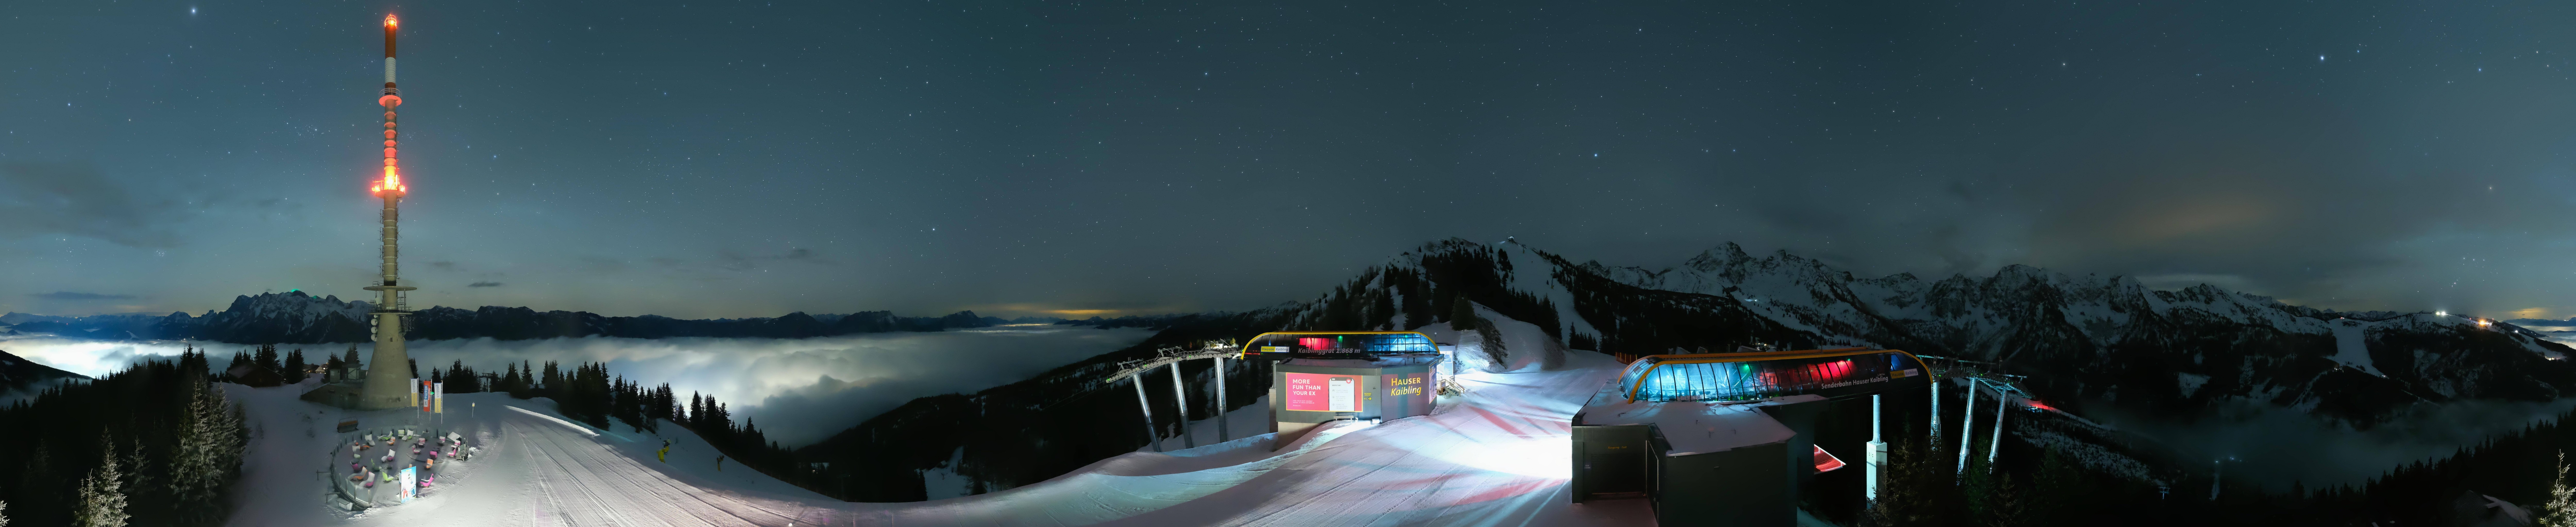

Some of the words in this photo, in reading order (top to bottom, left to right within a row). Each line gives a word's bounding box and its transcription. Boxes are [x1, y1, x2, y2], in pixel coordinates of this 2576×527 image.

[1391, 377, 1421, 386] HAUSER
[1821, 380, 1852, 389] Senderbahn
[1391, 386, 1421, 396] Kaibling
